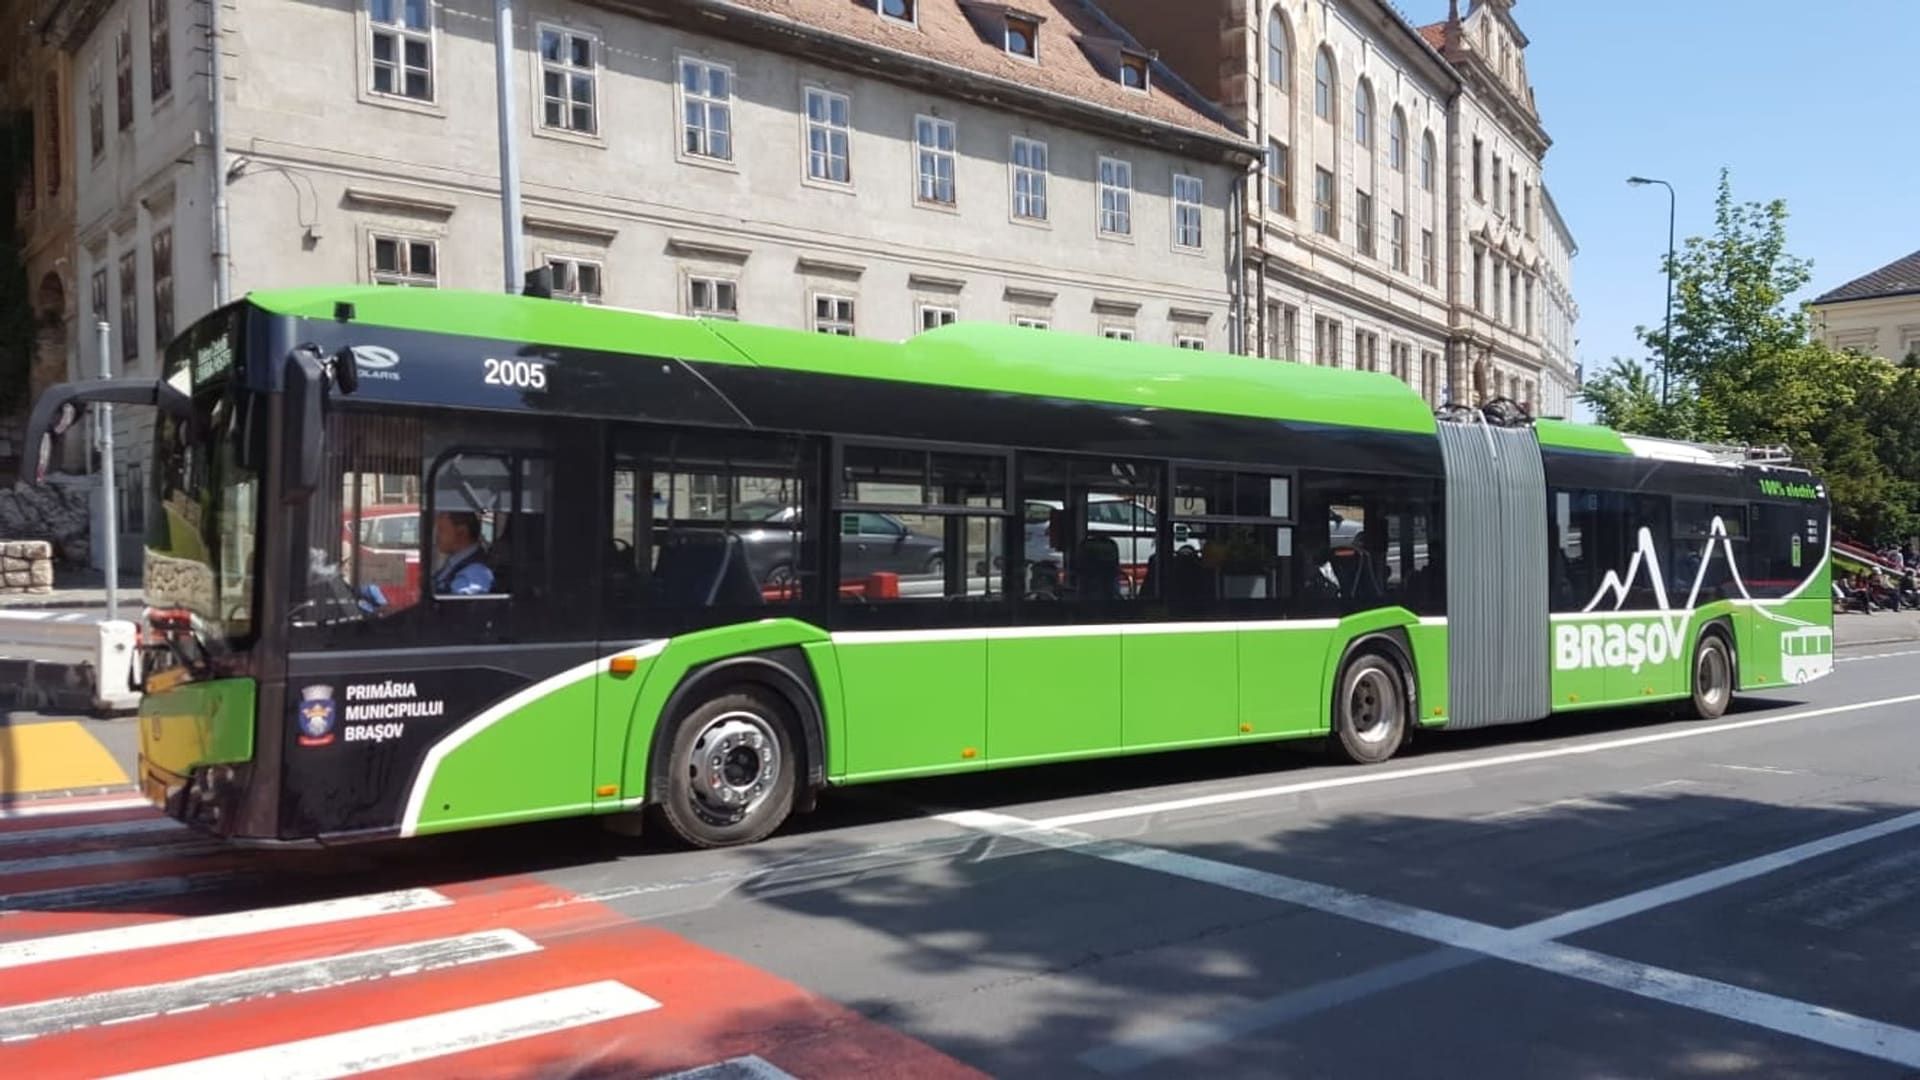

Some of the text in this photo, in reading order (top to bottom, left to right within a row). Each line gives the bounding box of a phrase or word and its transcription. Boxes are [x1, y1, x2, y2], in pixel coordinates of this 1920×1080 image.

[357, 369, 400, 381] OLARIS
[484, 358, 545, 388] 2005
[346, 681, 416, 700] PRIMĂRIA
[345, 701, 444, 720] MUNICIPIULUI
[345, 723, 404, 742] BRAȘOV
